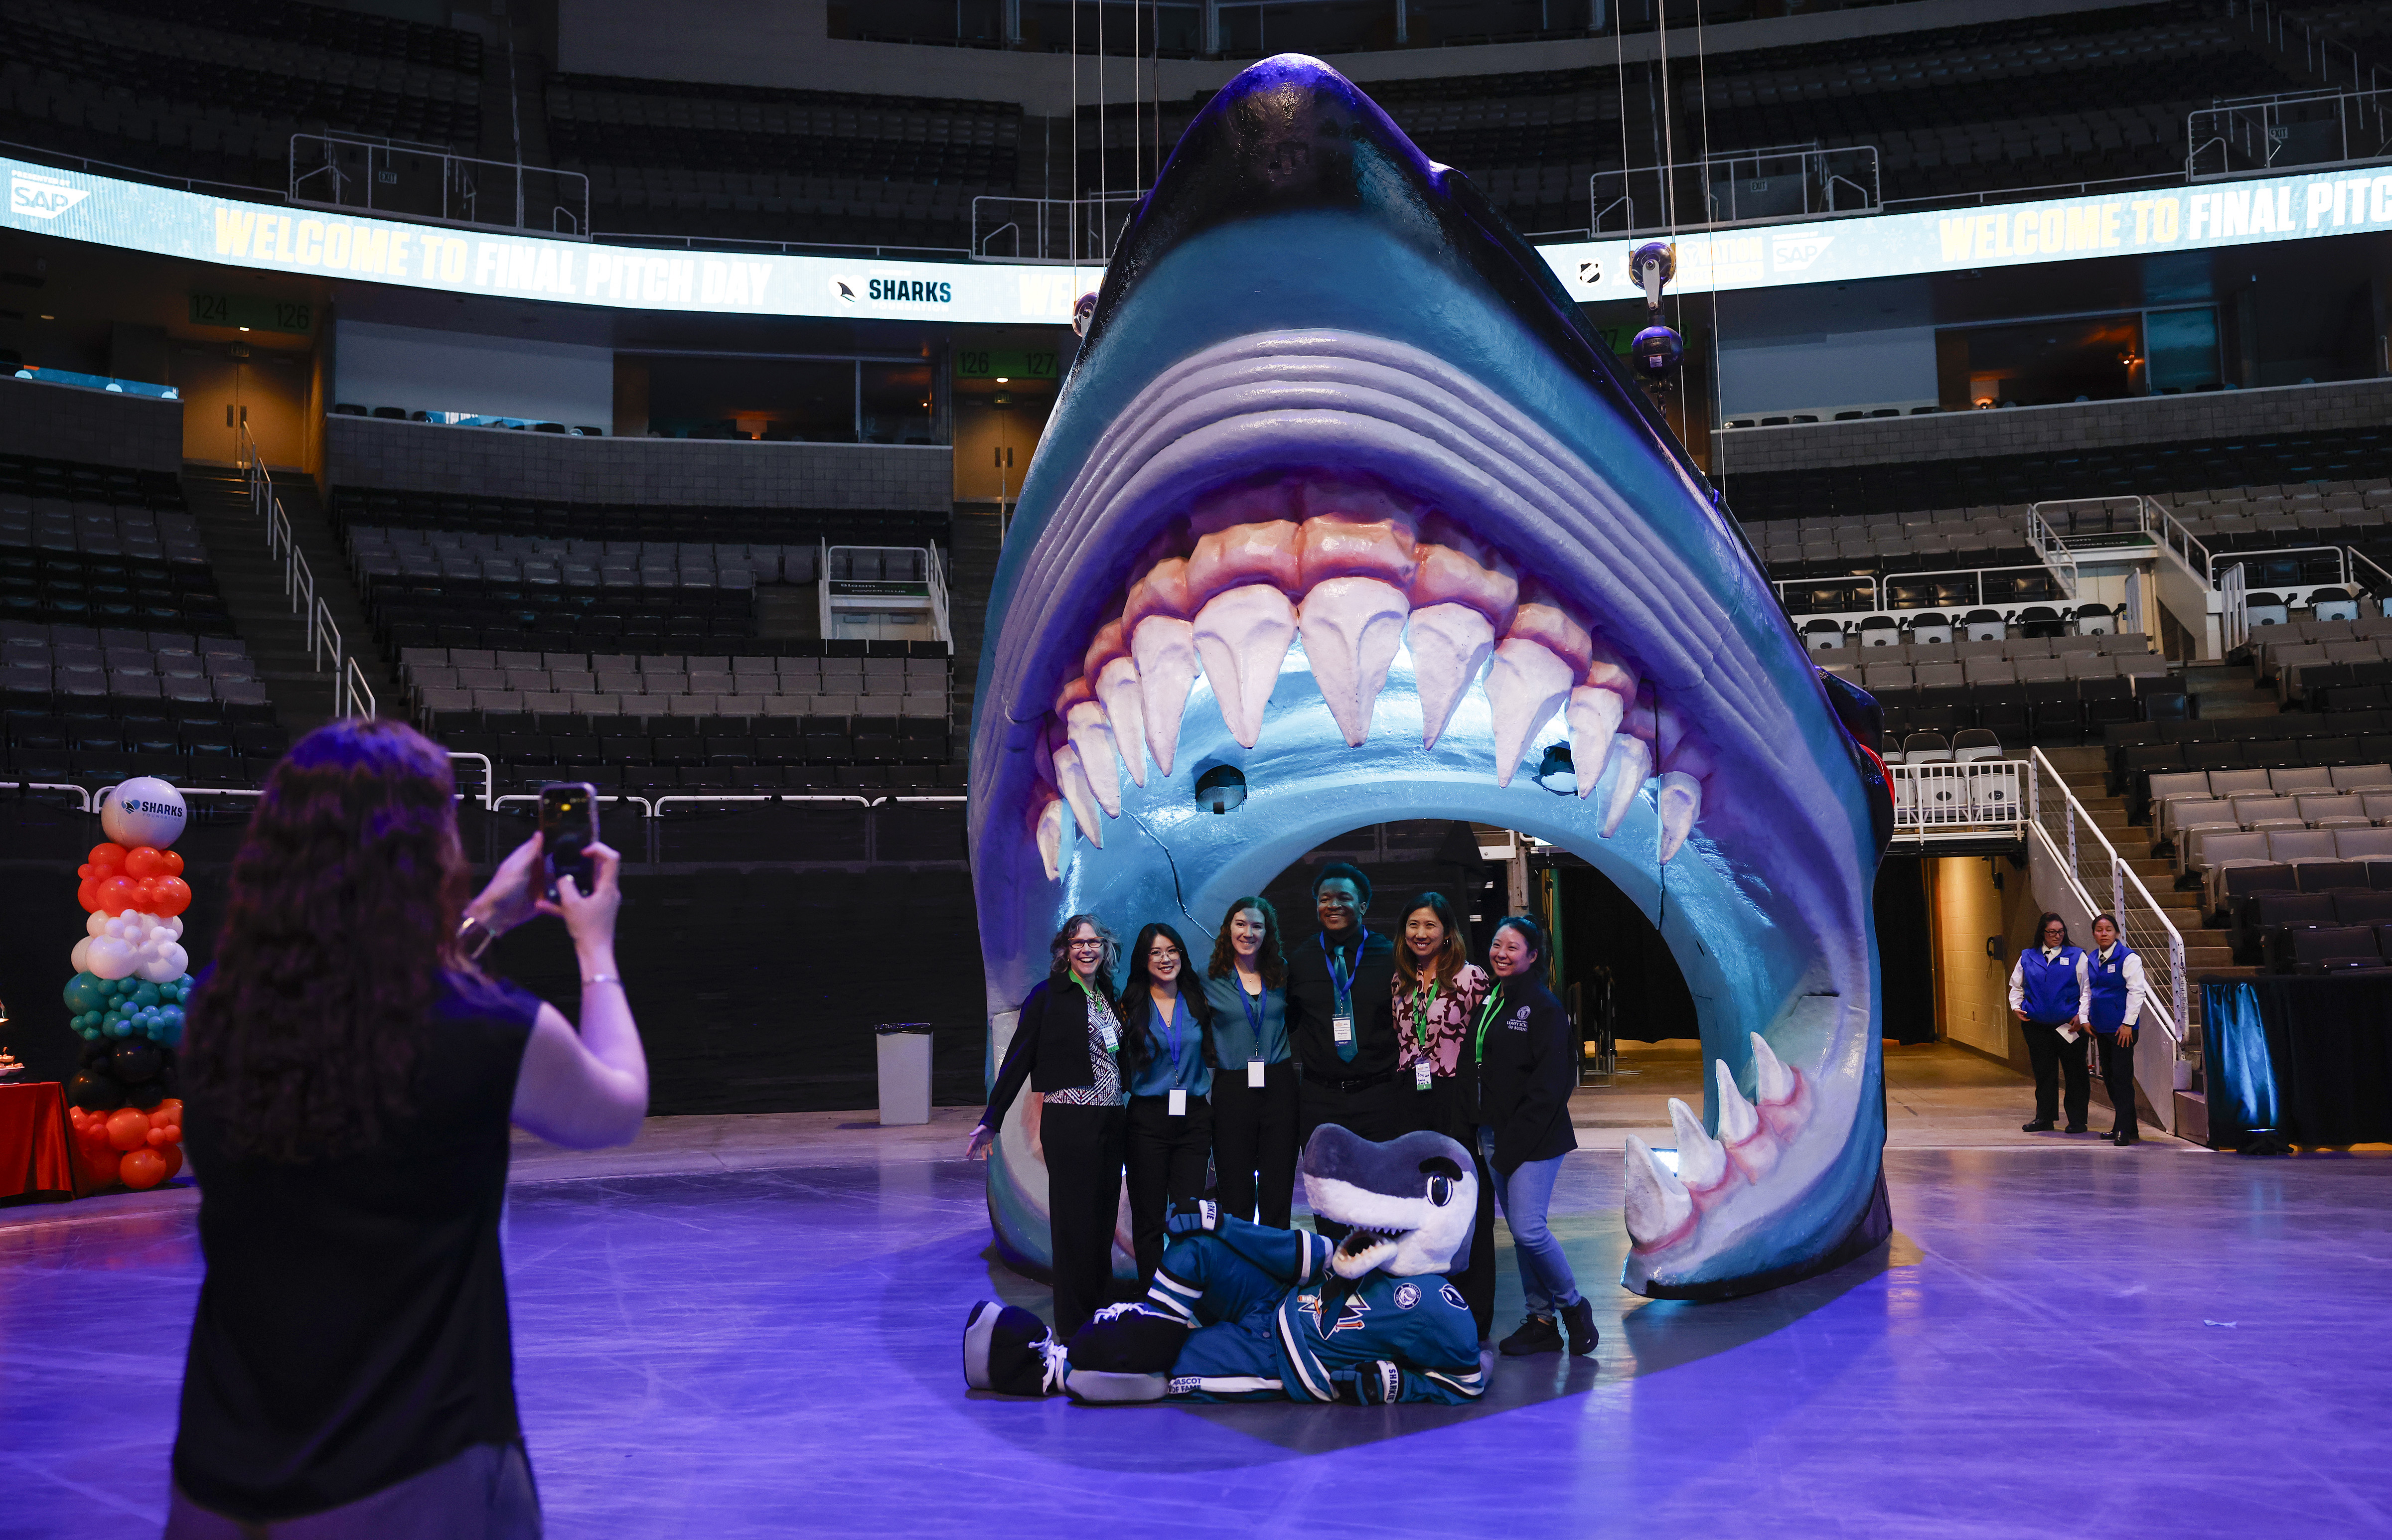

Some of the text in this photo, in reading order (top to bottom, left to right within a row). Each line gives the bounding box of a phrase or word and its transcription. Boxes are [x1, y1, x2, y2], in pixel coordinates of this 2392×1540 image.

[14, 186, 69, 212] SAP
[1939, 200, 2121, 262] WELCOME
[2131, 197, 2179, 246] TO
[2188, 186, 2296, 240] FINAL
[215, 207, 773, 305] WELCOME TO FINAL PITCH DAY
[1776, 246, 1818, 264] SAP
[869, 278, 953, 303] SHARKS
[193, 294, 309, 329] 124 126
[872, 301, 949, 312] FOUNDATION
[960, 351, 1055, 374] 126 127
[142, 801, 182, 817] SHARKS
[1386, 1369, 1397, 1400] SHARKIE
